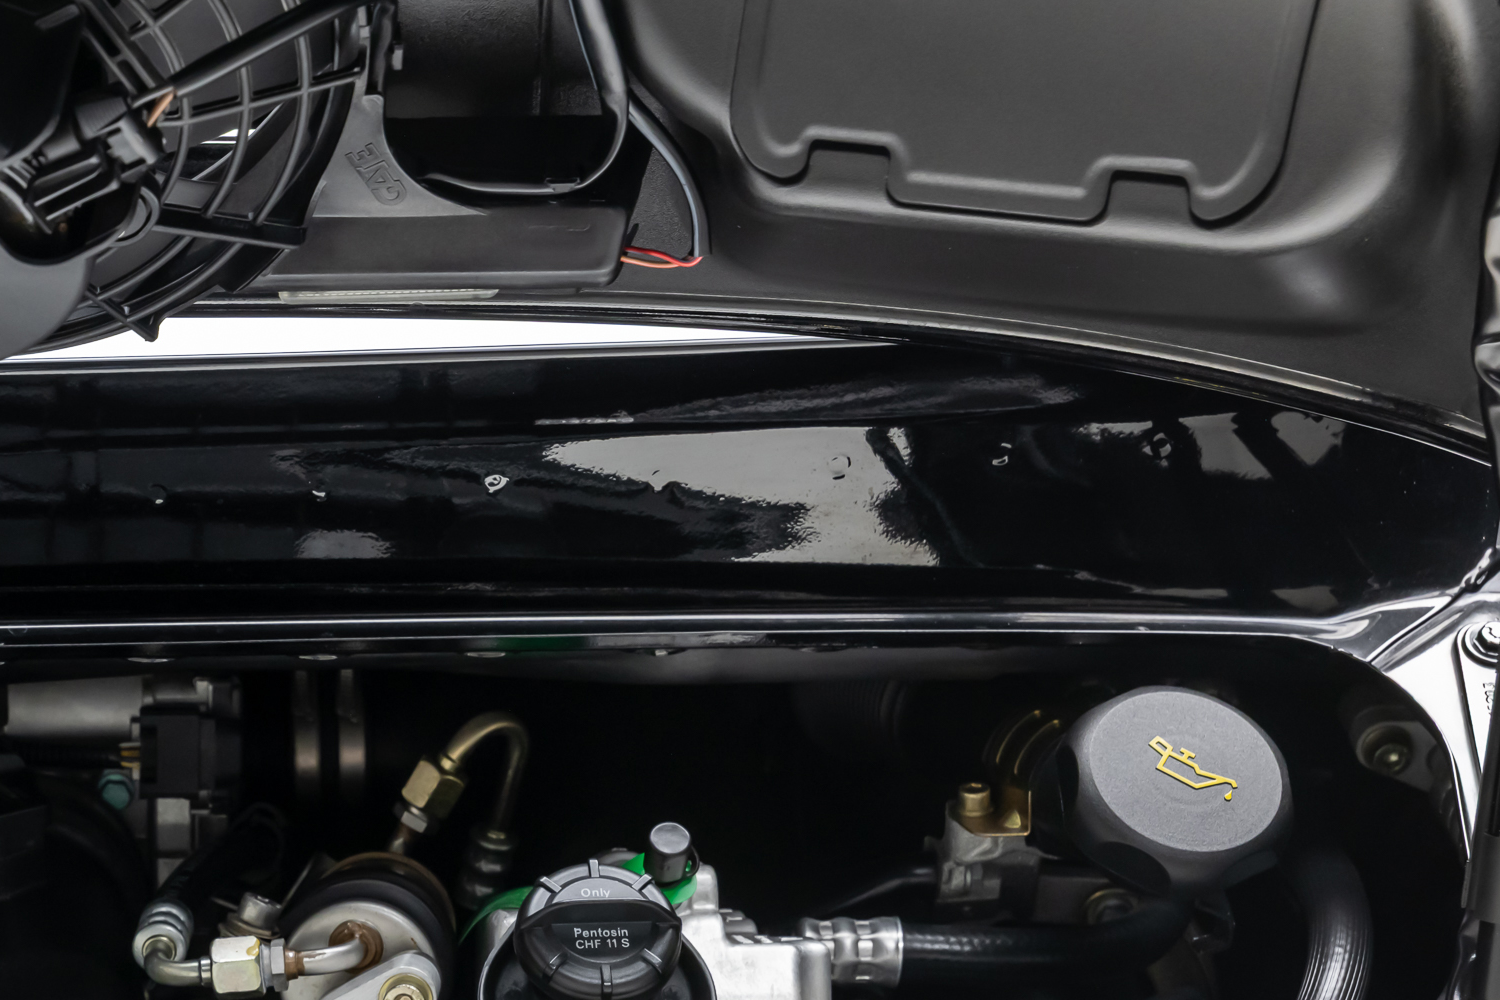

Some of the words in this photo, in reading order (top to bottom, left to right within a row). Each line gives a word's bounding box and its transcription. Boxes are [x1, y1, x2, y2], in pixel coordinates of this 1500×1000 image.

[580, 888, 610, 898] Only
[573, 927, 629, 938] Pentosin
[575, 939, 601, 949] CHF
[606, 939, 617, 948] 11
[621, 938, 630, 948] S
